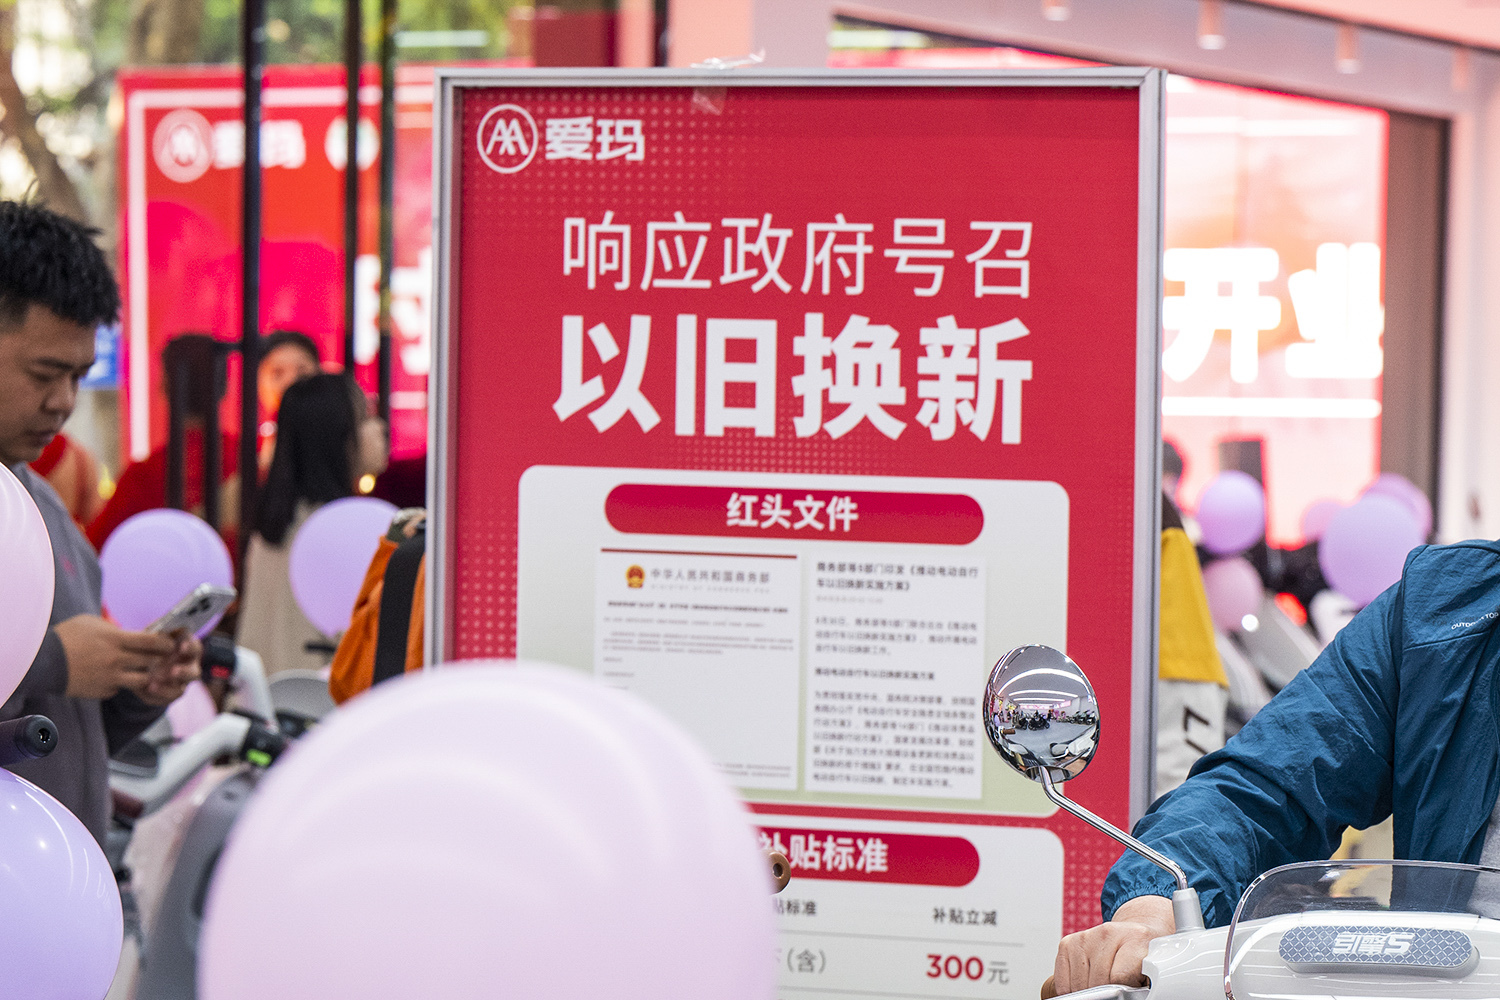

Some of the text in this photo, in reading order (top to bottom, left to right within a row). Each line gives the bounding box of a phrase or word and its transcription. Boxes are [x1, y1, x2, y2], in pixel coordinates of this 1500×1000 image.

[545, 116, 646, 162] 爱玛
[563, 210, 1033, 299] 响应政府号召
[552, 312, 1033, 445] 以旧换新
[726, 492, 859, 532] 红头文件
[759, 832, 889, 873] 补贴标准
[932, 907, 998, 927] 补贴立减
[1333, 931, 1416, 955] 引擎S
[777, 947, 1009, 985] （含） 300元
